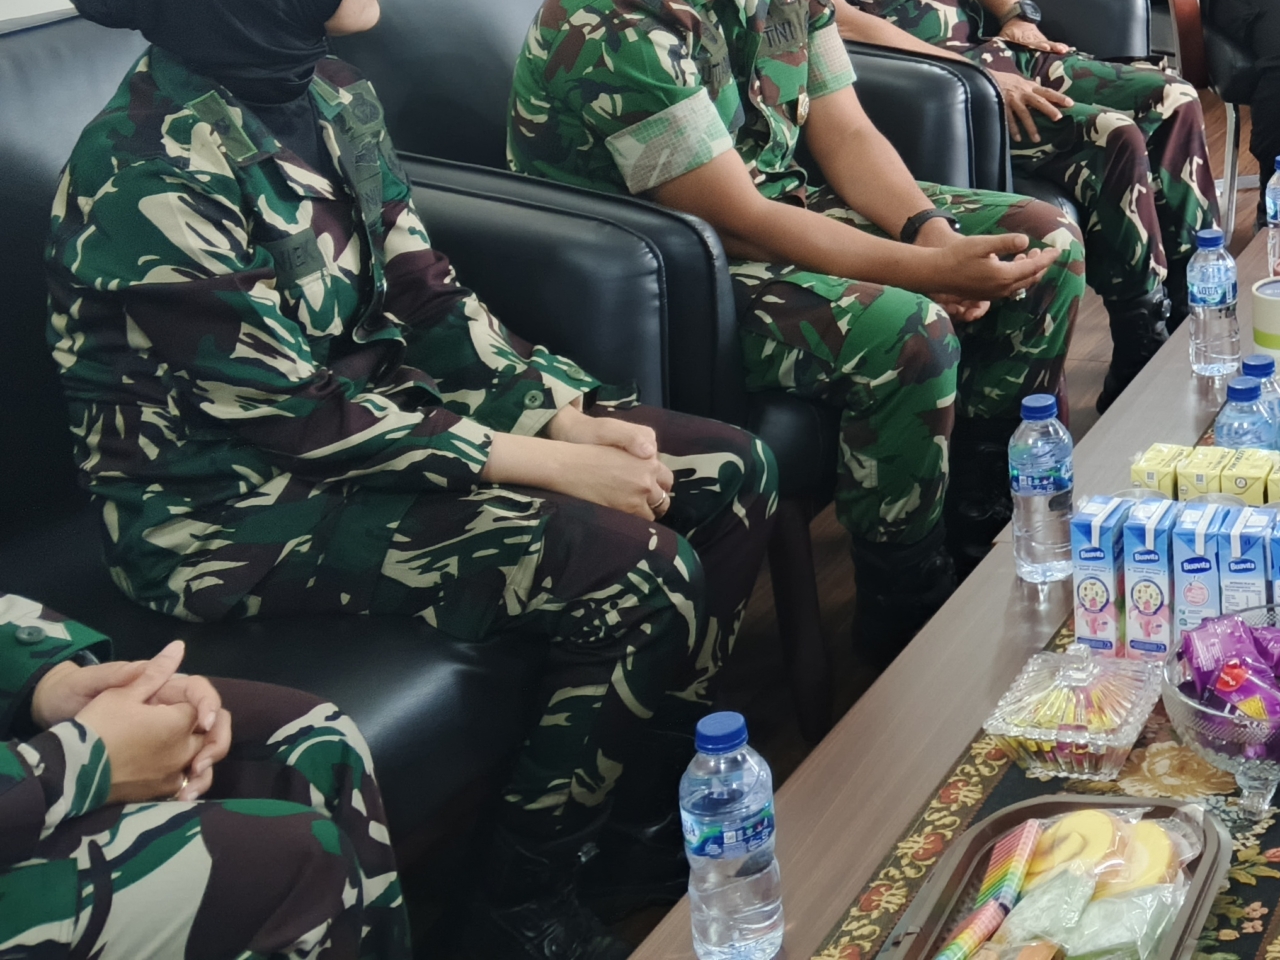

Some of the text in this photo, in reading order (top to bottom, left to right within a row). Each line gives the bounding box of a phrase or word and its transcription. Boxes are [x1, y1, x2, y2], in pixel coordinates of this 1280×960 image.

[763, 21, 796, 48] TNI
[1196, 286, 1219, 295] AQUA
[1080, 549, 1104, 558] Buavita
[1134, 552, 1159, 561] Buavita
[1183, 561, 1210, 570] Buavita
[1229, 562, 1256, 571] Buavita
